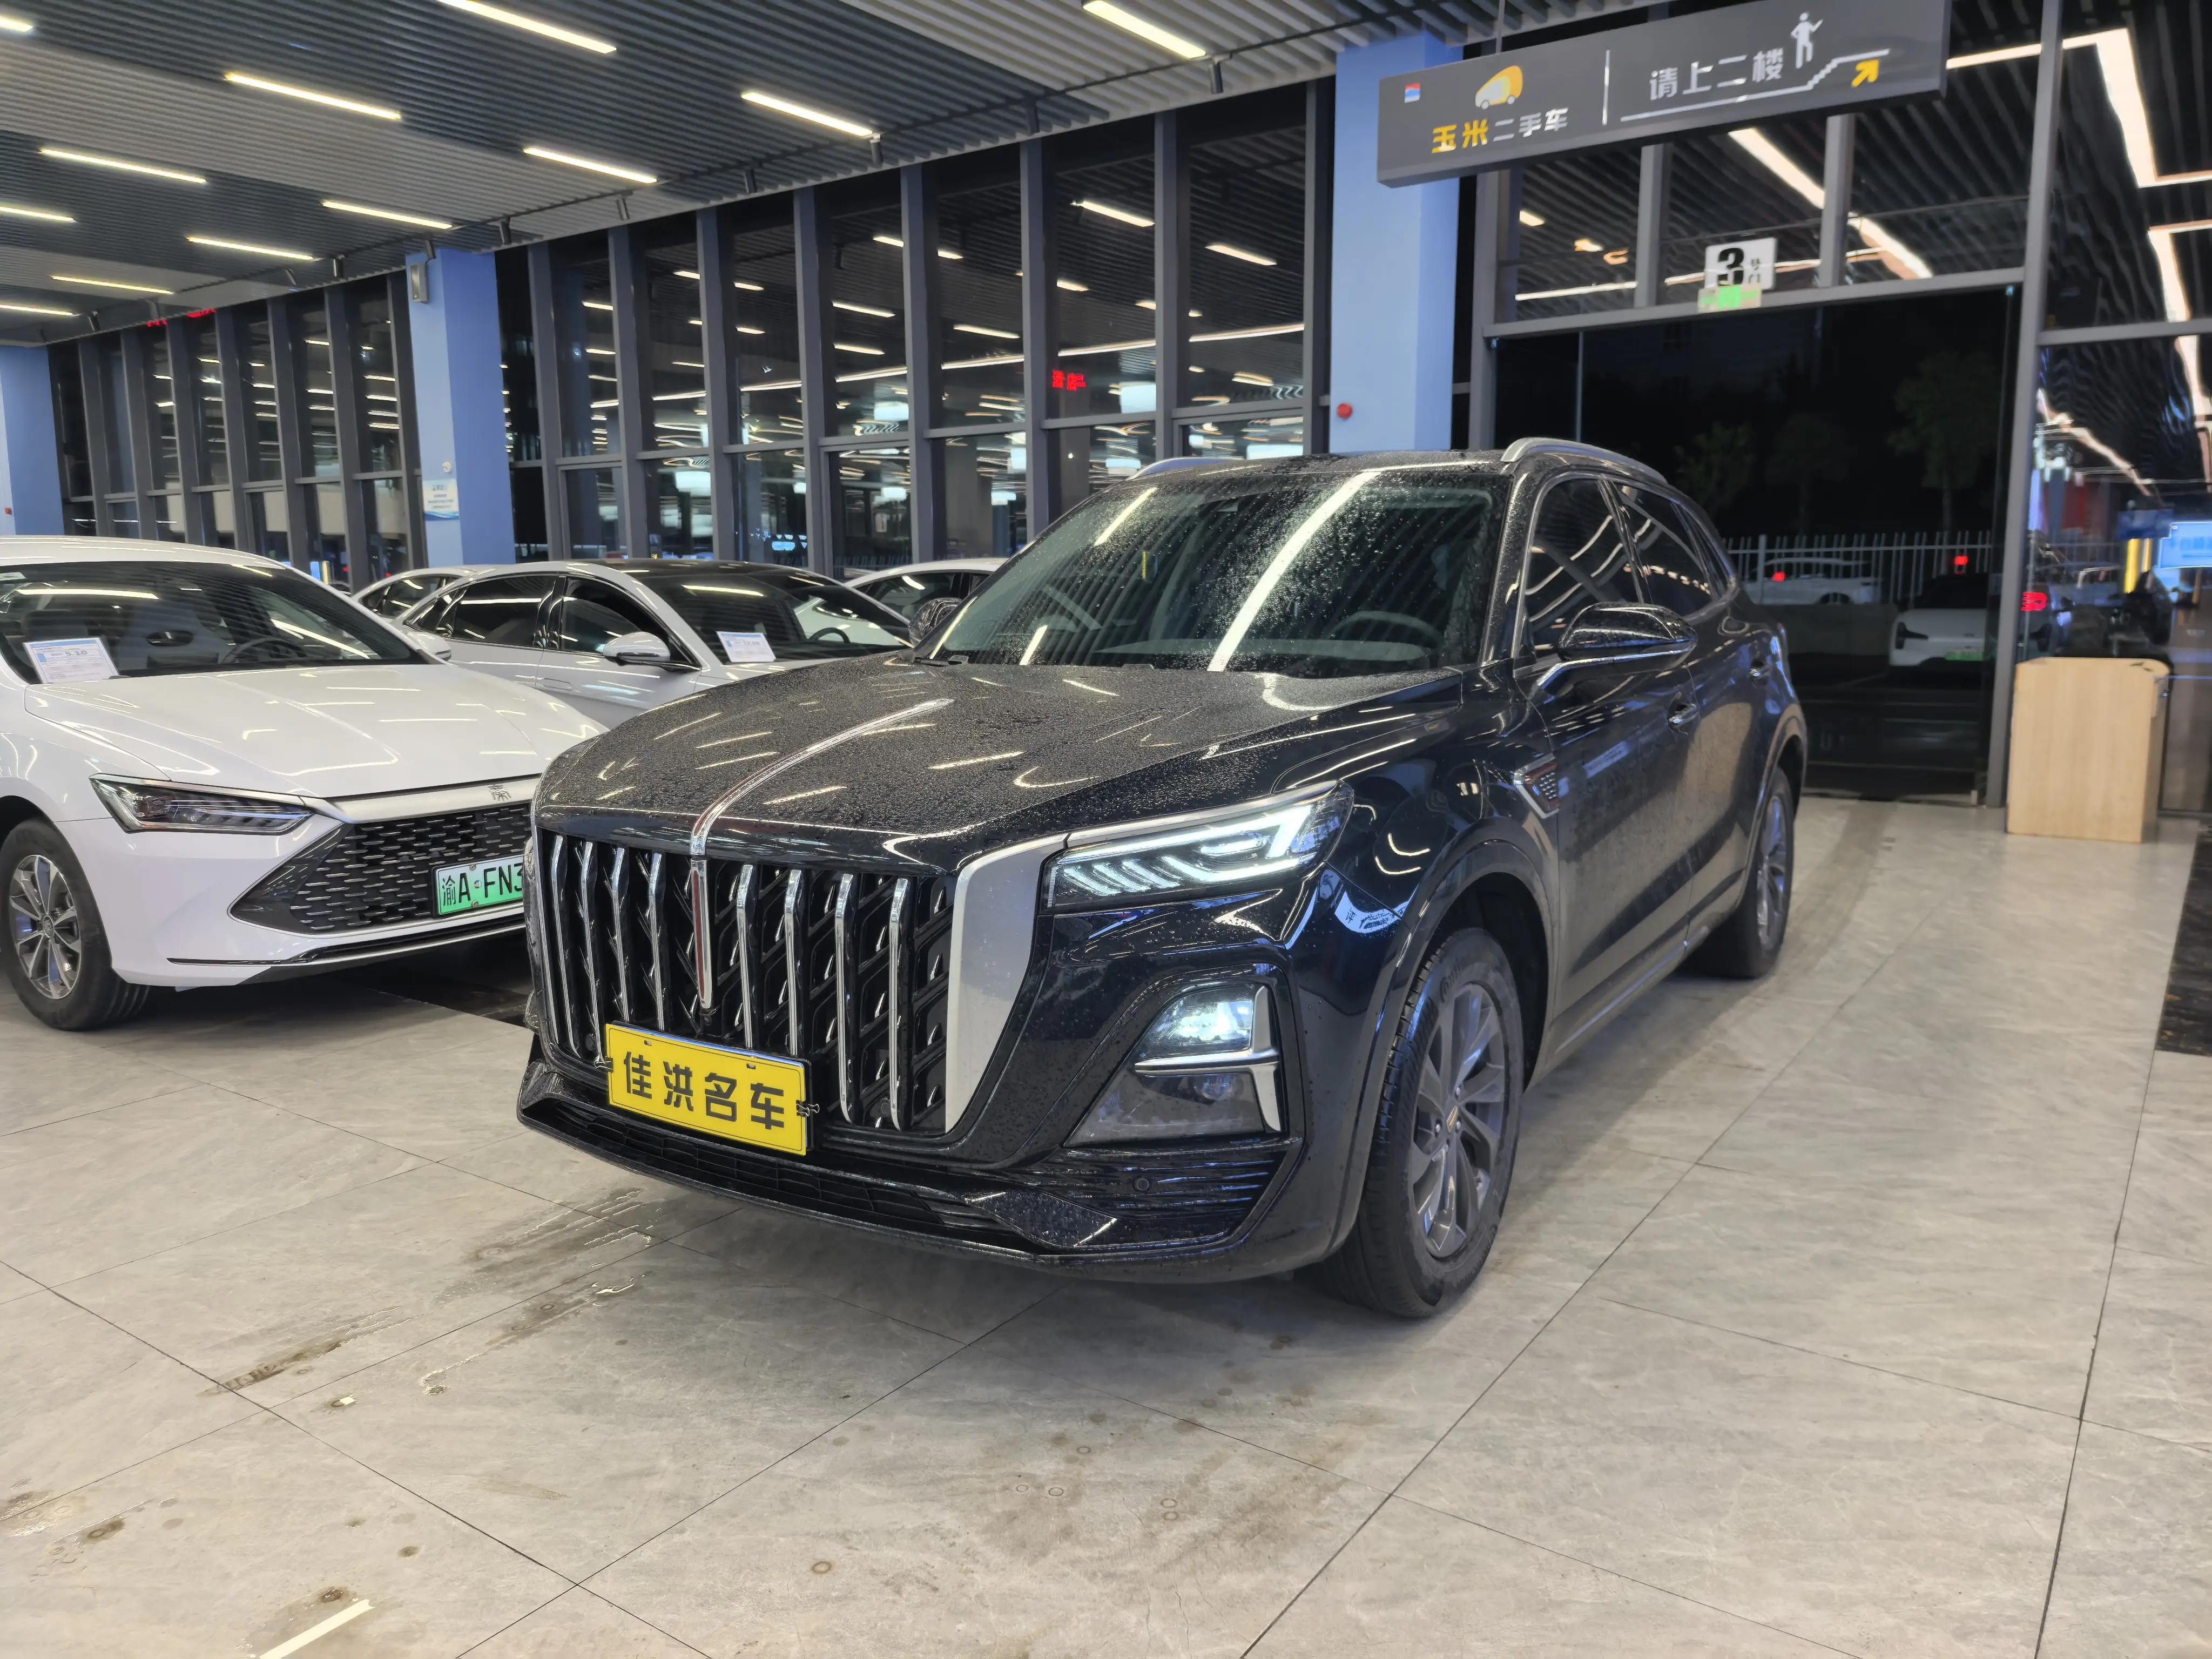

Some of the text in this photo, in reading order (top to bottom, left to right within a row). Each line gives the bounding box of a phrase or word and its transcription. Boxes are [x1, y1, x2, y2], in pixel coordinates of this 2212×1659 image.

[1649, 47, 1784, 100] 请上二楼
[1431, 107, 1569, 153] 玉米二手车
[1717, 247, 1744, 286] 3
[623, 1051, 785, 1130] 佳洪名车
